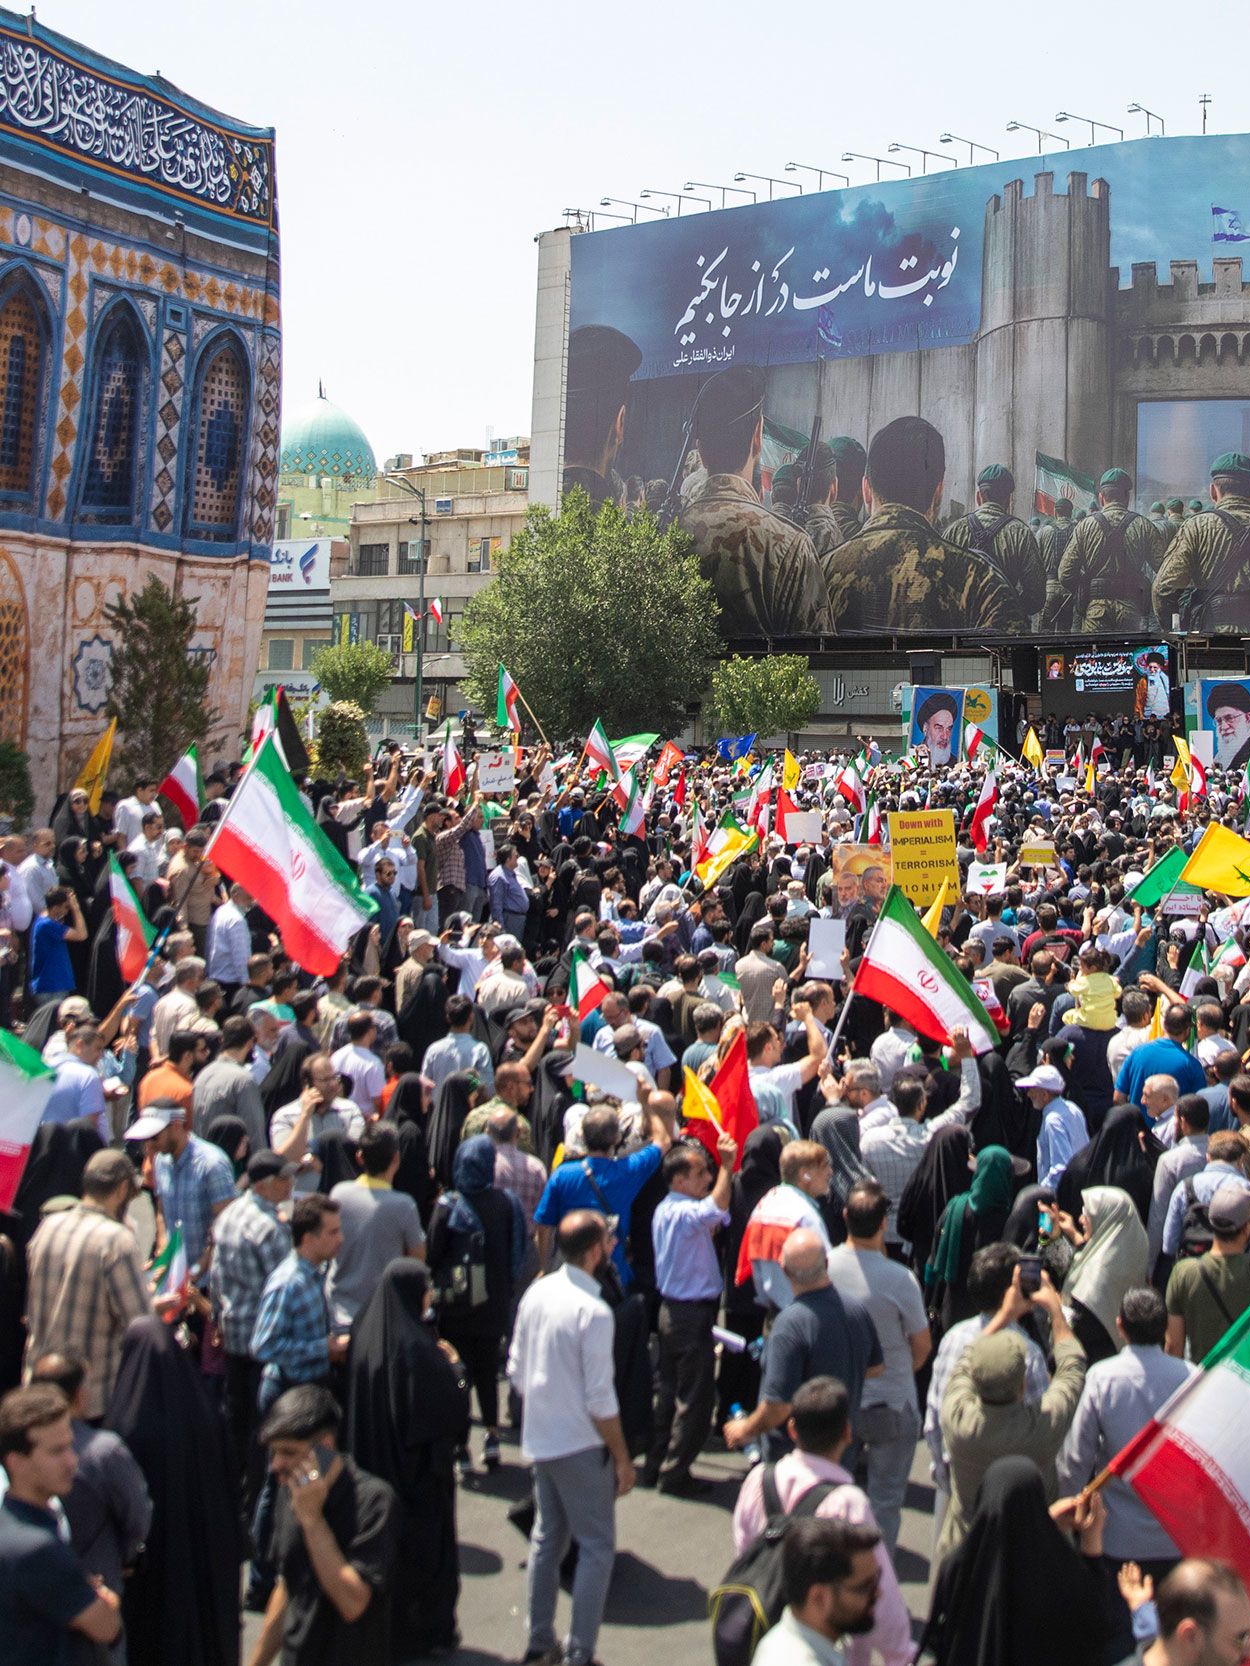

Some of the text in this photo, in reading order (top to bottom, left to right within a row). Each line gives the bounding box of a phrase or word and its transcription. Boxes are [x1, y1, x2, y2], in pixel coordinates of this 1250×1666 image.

[878, 226, 961, 307] نوبت
[740, 260, 764, 316] از
[793, 254, 876, 310] ماست
[674, 246, 729, 346] بکنیم
[720, 274, 743, 337] جا
[673, 351, 689, 367] علی
[716, 345, 735, 361] ایران
[272, 572, 293, 583] BANK
[847, 686, 869, 699] کفش
[899, 818, 943, 830] Down with
[892, 834, 953, 846] IMPERIALISM
[895, 859, 955, 870] TERRORISM
[900, 882, 958, 893] IONISM
